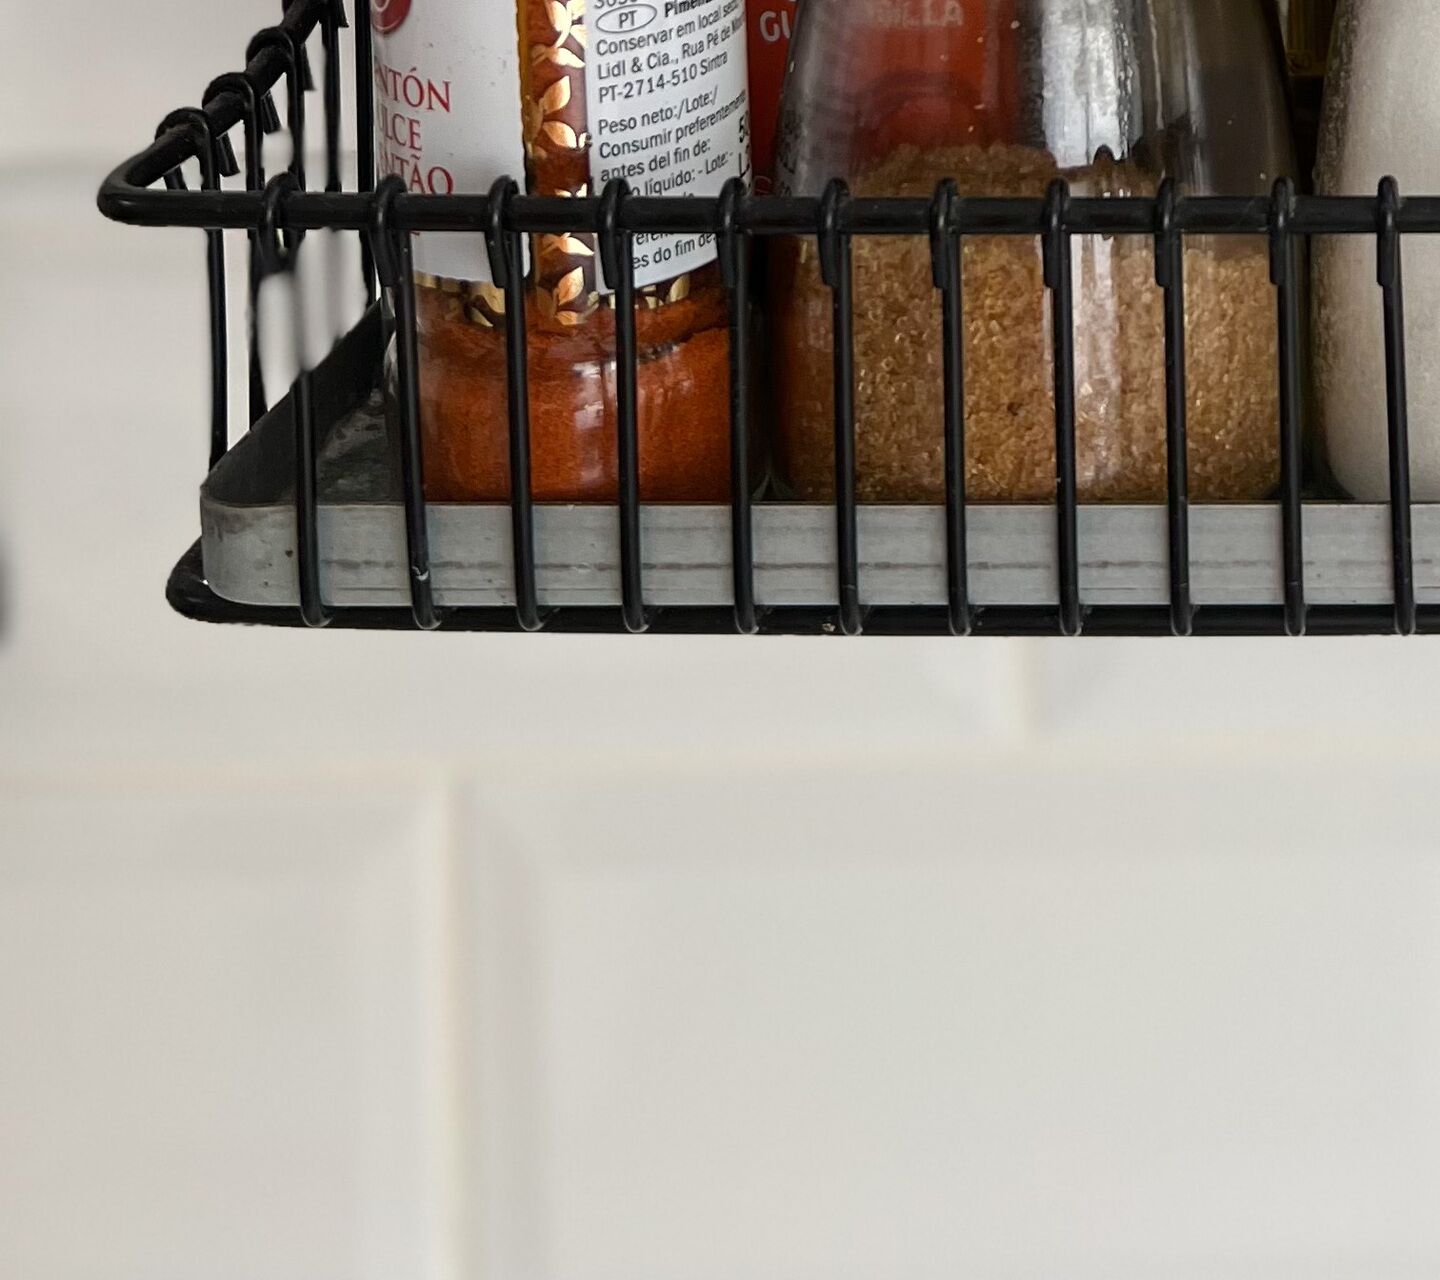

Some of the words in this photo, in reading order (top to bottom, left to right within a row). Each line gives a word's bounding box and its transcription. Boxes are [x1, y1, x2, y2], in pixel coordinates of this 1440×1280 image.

[596, 28, 673, 56] Conservar
[676, 20, 696, 39] em
[698, 5, 722, 30] local
[618, 10, 637, 29] PT
[597, 61, 626, 80] Lidl
[631, 56, 643, 73] &
[682, 40, 705, 60] Rua
[599, 68, 697, 104] PT-2714-510
[598, 116, 637, 136] Peso
[600, 128, 673, 159] Consumir
[600, 162, 645, 183] antes
[648, 150, 671, 171] del
[674, 146, 690, 164] fin
[653, 246, 672, 264] do
[675, 240, 696, 256] fim
